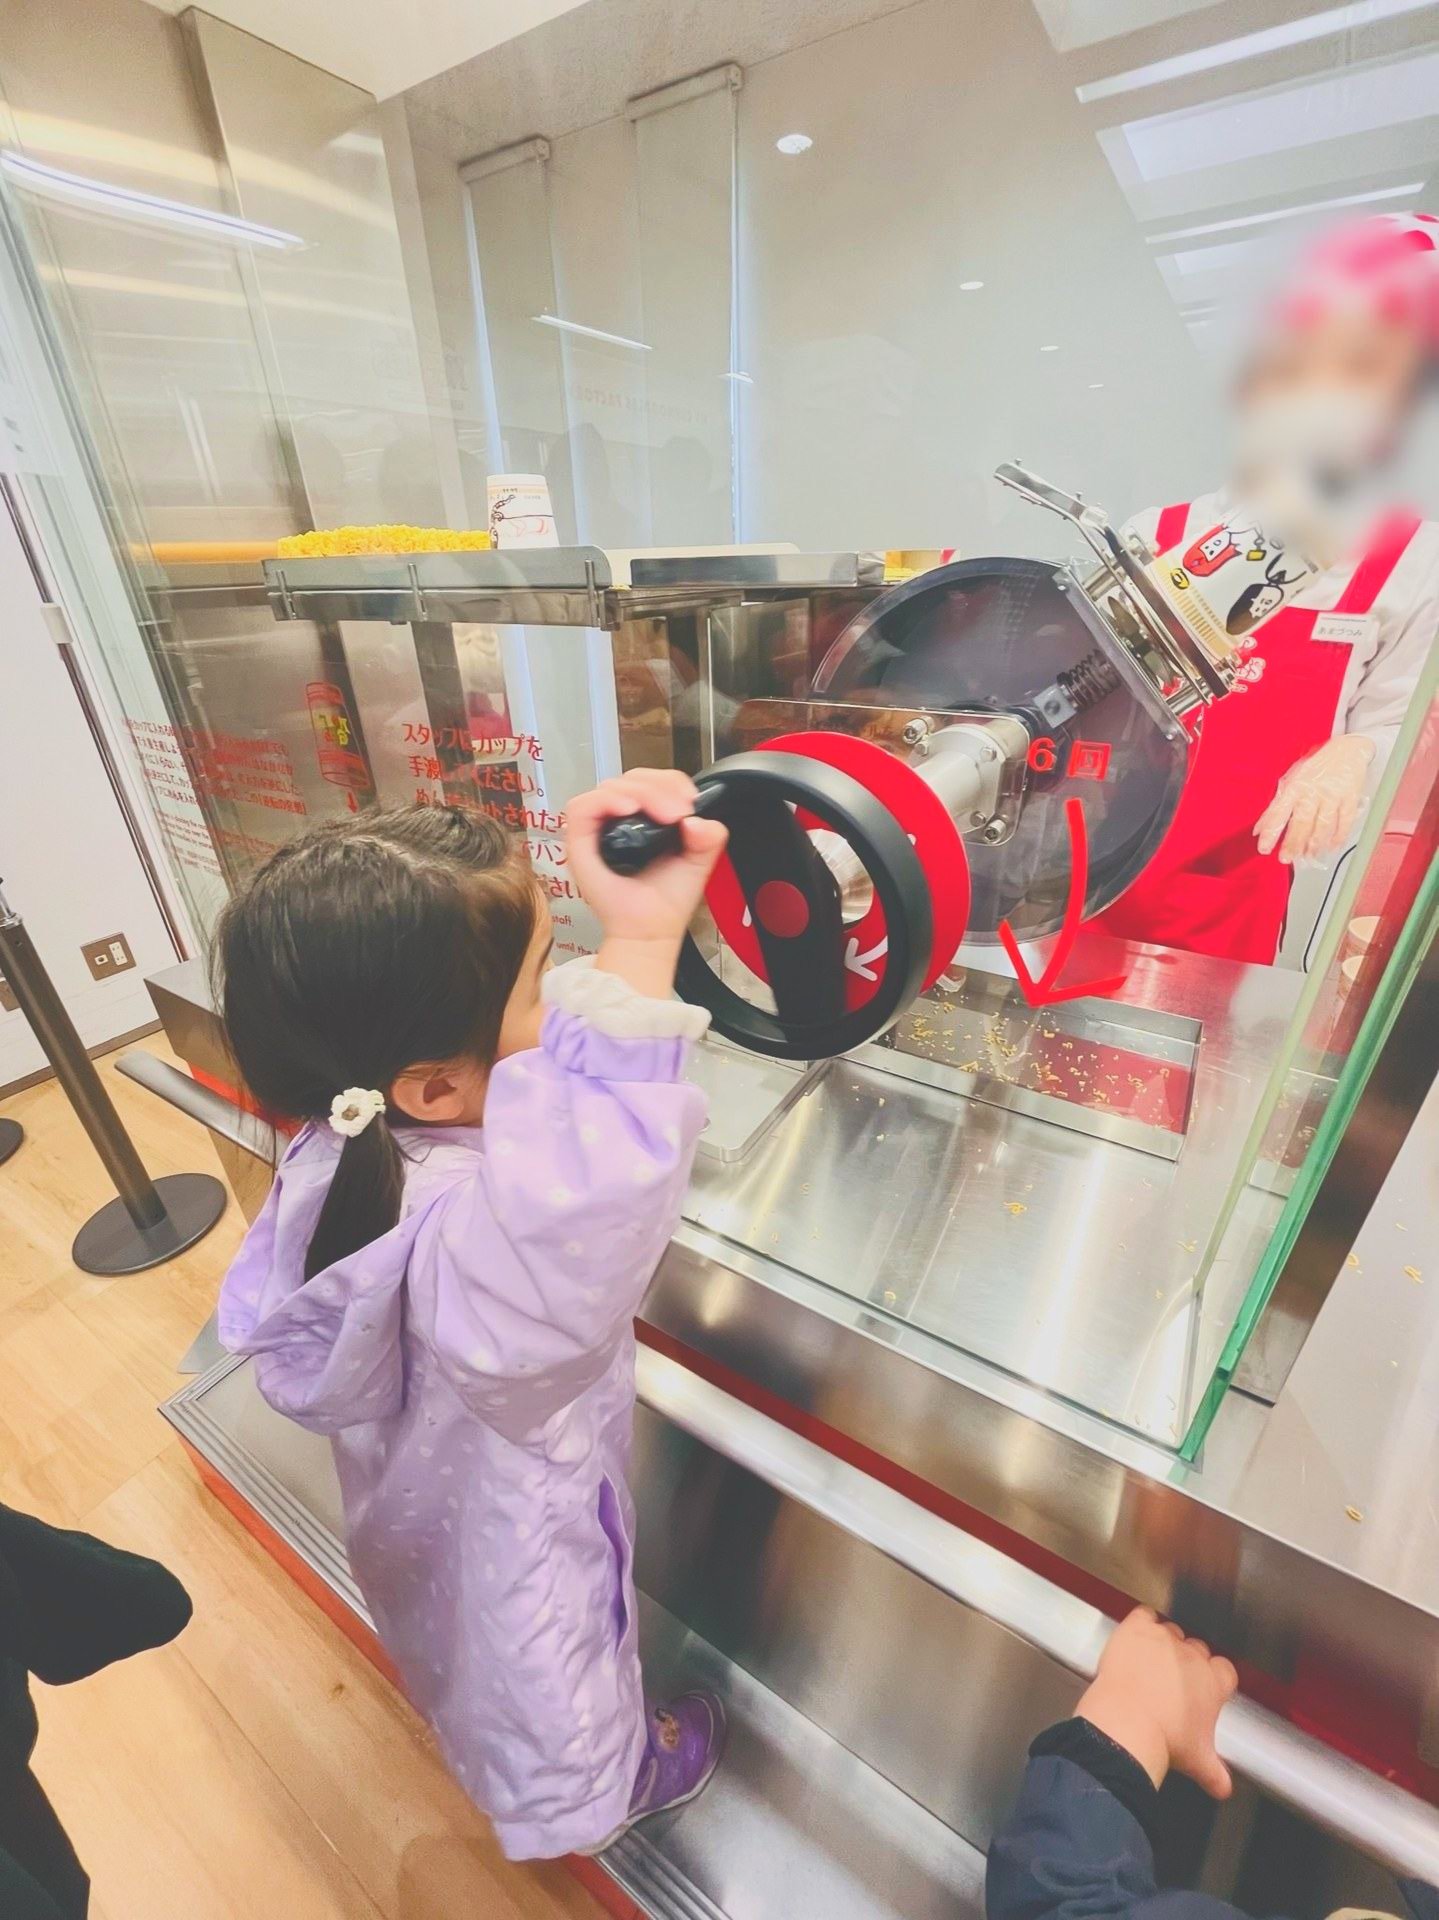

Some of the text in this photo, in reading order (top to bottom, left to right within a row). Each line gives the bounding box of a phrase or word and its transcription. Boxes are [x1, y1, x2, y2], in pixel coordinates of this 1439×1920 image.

[401, 723, 544, 762] スタッフにカップを
[408, 755, 545, 798] 手渡してください。
